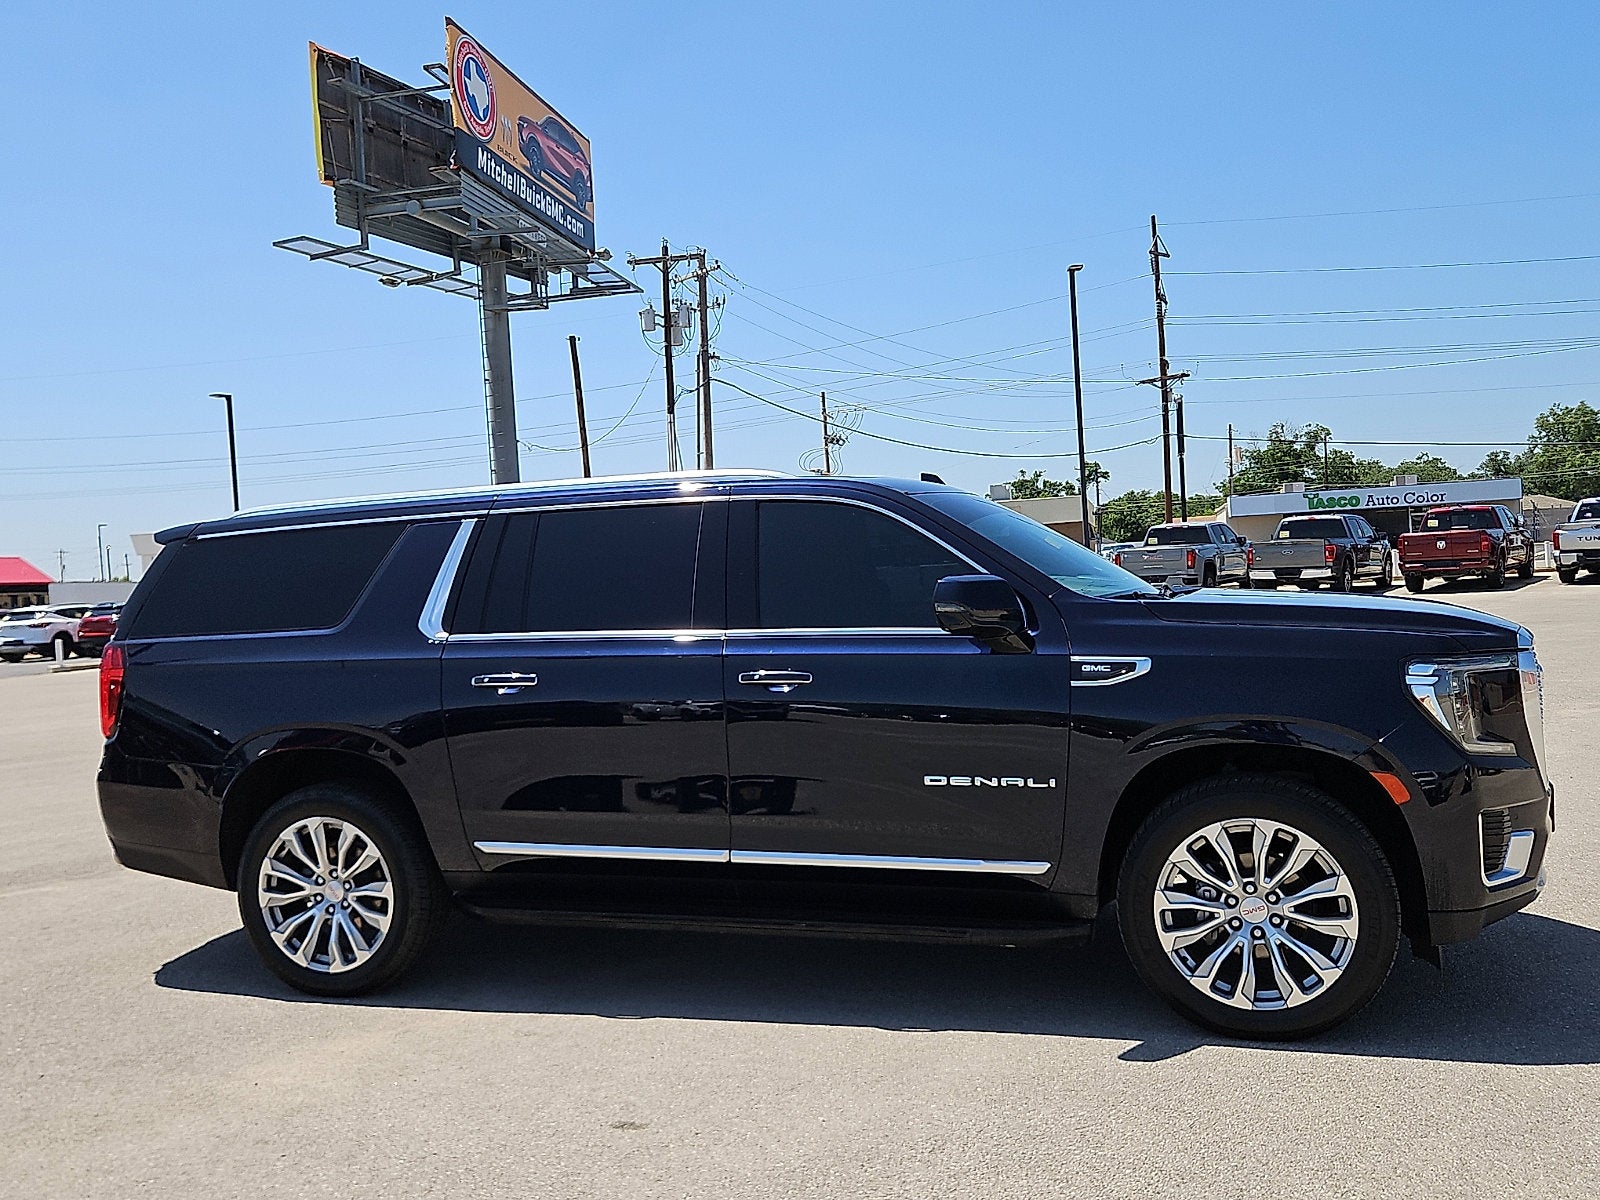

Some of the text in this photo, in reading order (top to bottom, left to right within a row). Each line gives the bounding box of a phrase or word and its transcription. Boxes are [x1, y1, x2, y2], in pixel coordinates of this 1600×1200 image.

[477, 146, 585, 238] MitchellBuickGMC.com
[1303, 491, 1447, 509] TASCO Auto Color
[1081, 664, 1111, 672] GMC
[923, 775, 1056, 788] DENALI
[1242, 905, 1266, 916] GMC
